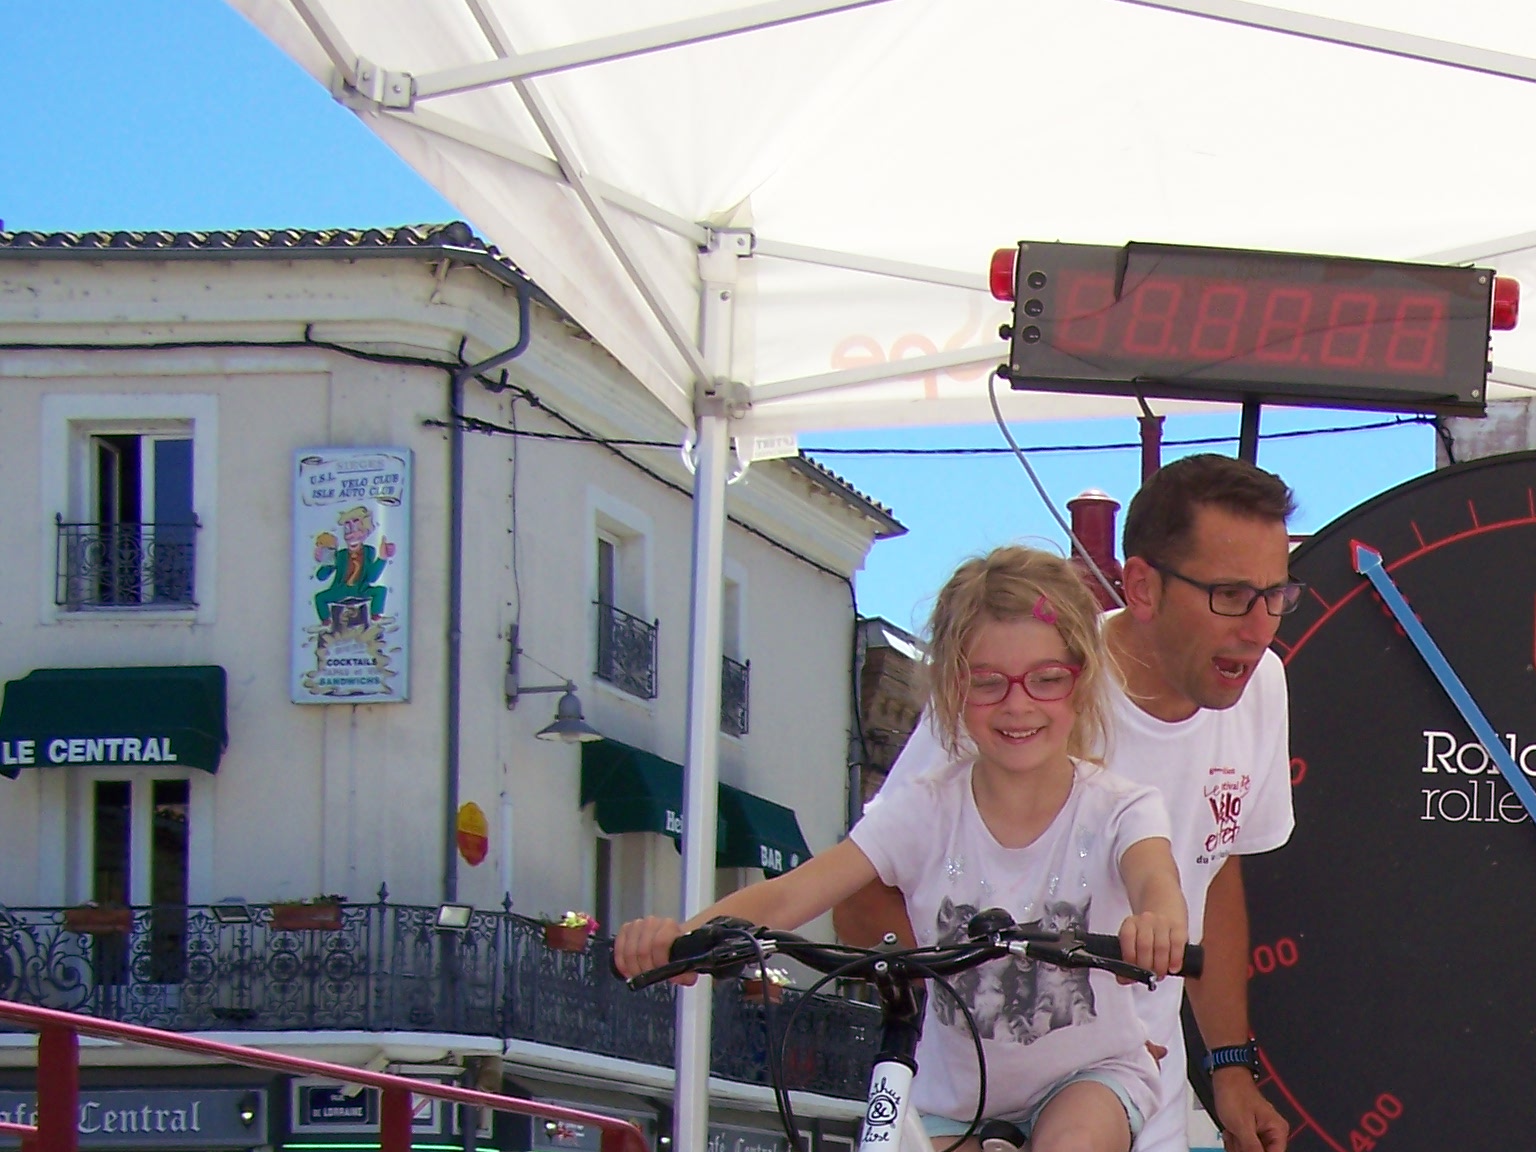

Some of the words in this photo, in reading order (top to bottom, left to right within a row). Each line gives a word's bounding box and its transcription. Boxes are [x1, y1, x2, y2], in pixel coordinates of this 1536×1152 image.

[373, 473, 399, 485] CLUB
[339, 487, 365, 498] AUTO
[369, 485, 395, 497] CLUB
[327, 658, 378, 667] COCKTAILS
[3, 740, 36, 765] LE
[48, 737, 178, 763] CENTRAL
[760, 844, 783, 873] BAR
[1247, 937, 1299, 980] 00
[77, 1100, 201, 1134] Central
[323, 1106, 363, 1118] LORRAINE
